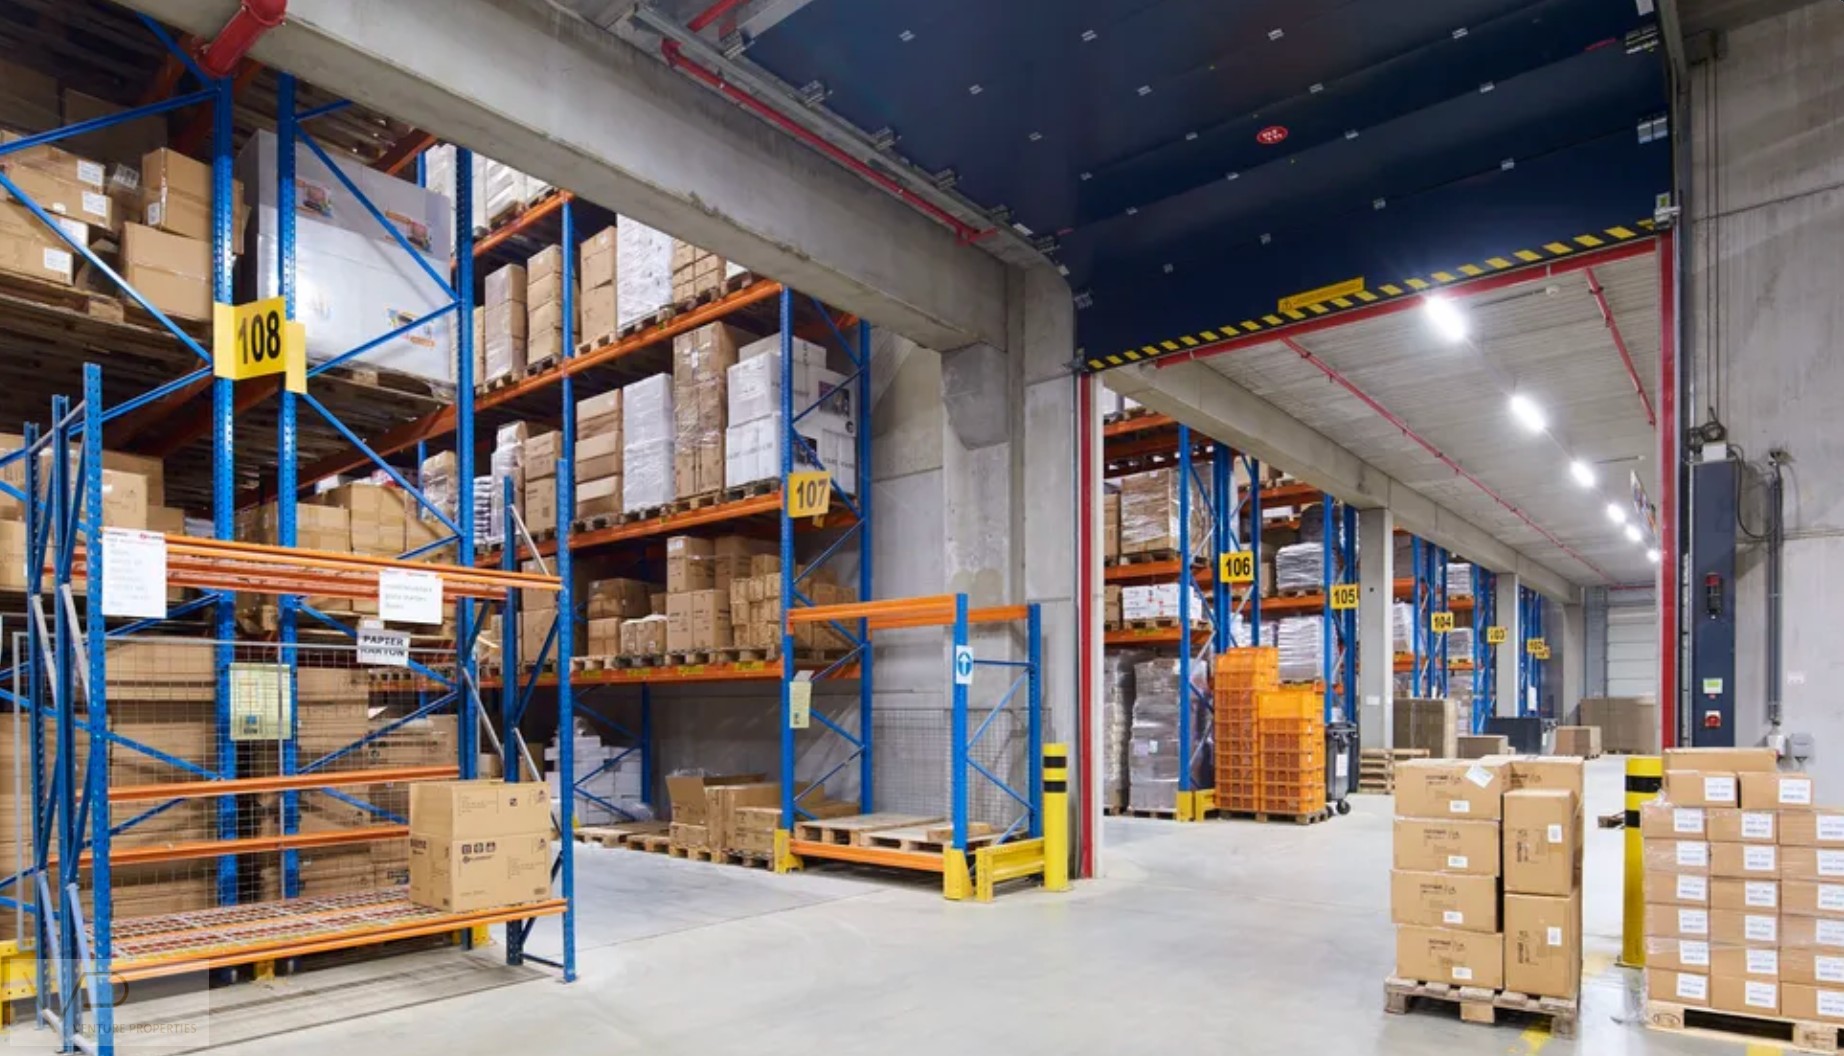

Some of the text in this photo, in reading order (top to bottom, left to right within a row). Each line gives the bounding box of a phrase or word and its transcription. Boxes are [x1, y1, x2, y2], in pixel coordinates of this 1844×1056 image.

[238, 310, 281, 365] 108
[797, 479, 828, 509] 107
[1225, 556, 1251, 577] 106
[1334, 588, 1356, 604] 105
[1434, 615, 1452, 629] 104
[363, 635, 405, 646] PAPIER
